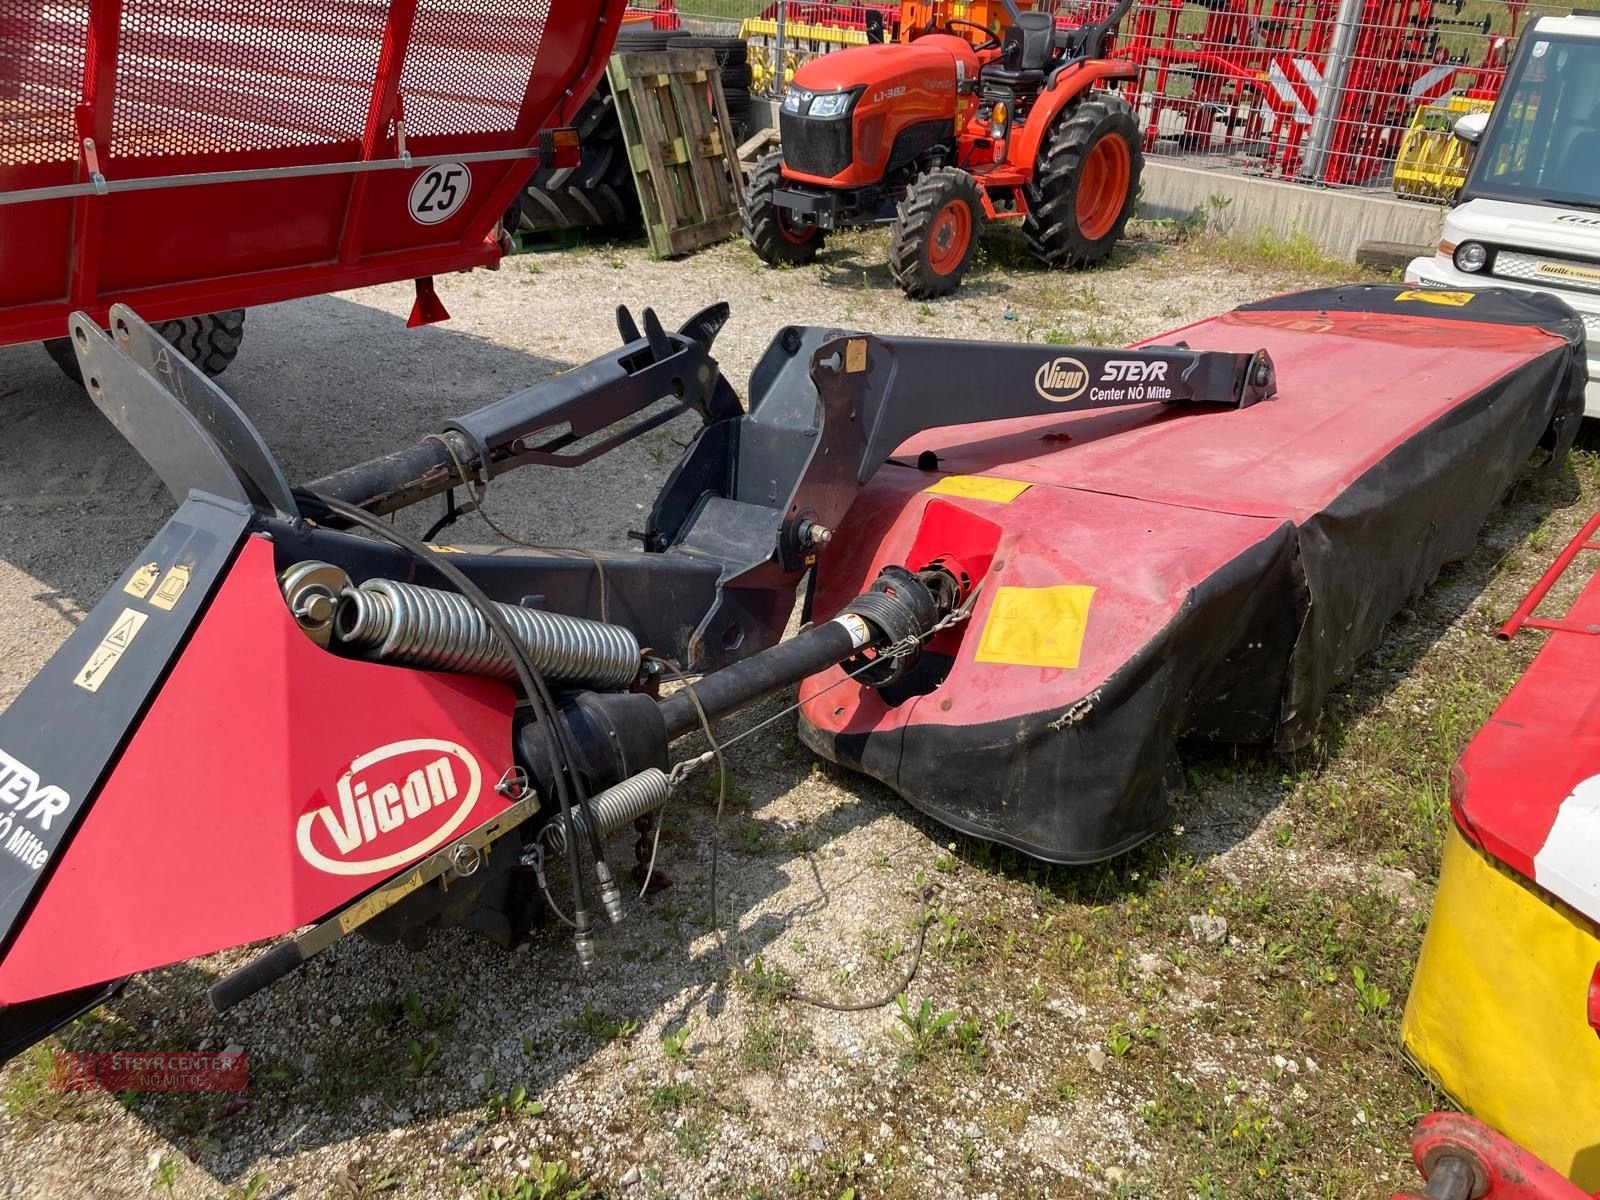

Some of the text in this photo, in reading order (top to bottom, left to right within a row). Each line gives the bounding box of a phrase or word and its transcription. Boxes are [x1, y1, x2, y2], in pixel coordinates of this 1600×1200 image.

[874, 86, 906, 102] L1-382
[417, 171, 462, 212] 25
[1041, 361, 1084, 389] Vicon
[1100, 360, 1168, 382] STEYR
[1090, 383, 1172, 400] Center NÖ Mitte
[0, 748, 71, 831] TEYR
[316, 756, 459, 856] Vicon
[0, 811, 49, 870] Ö Mitte
